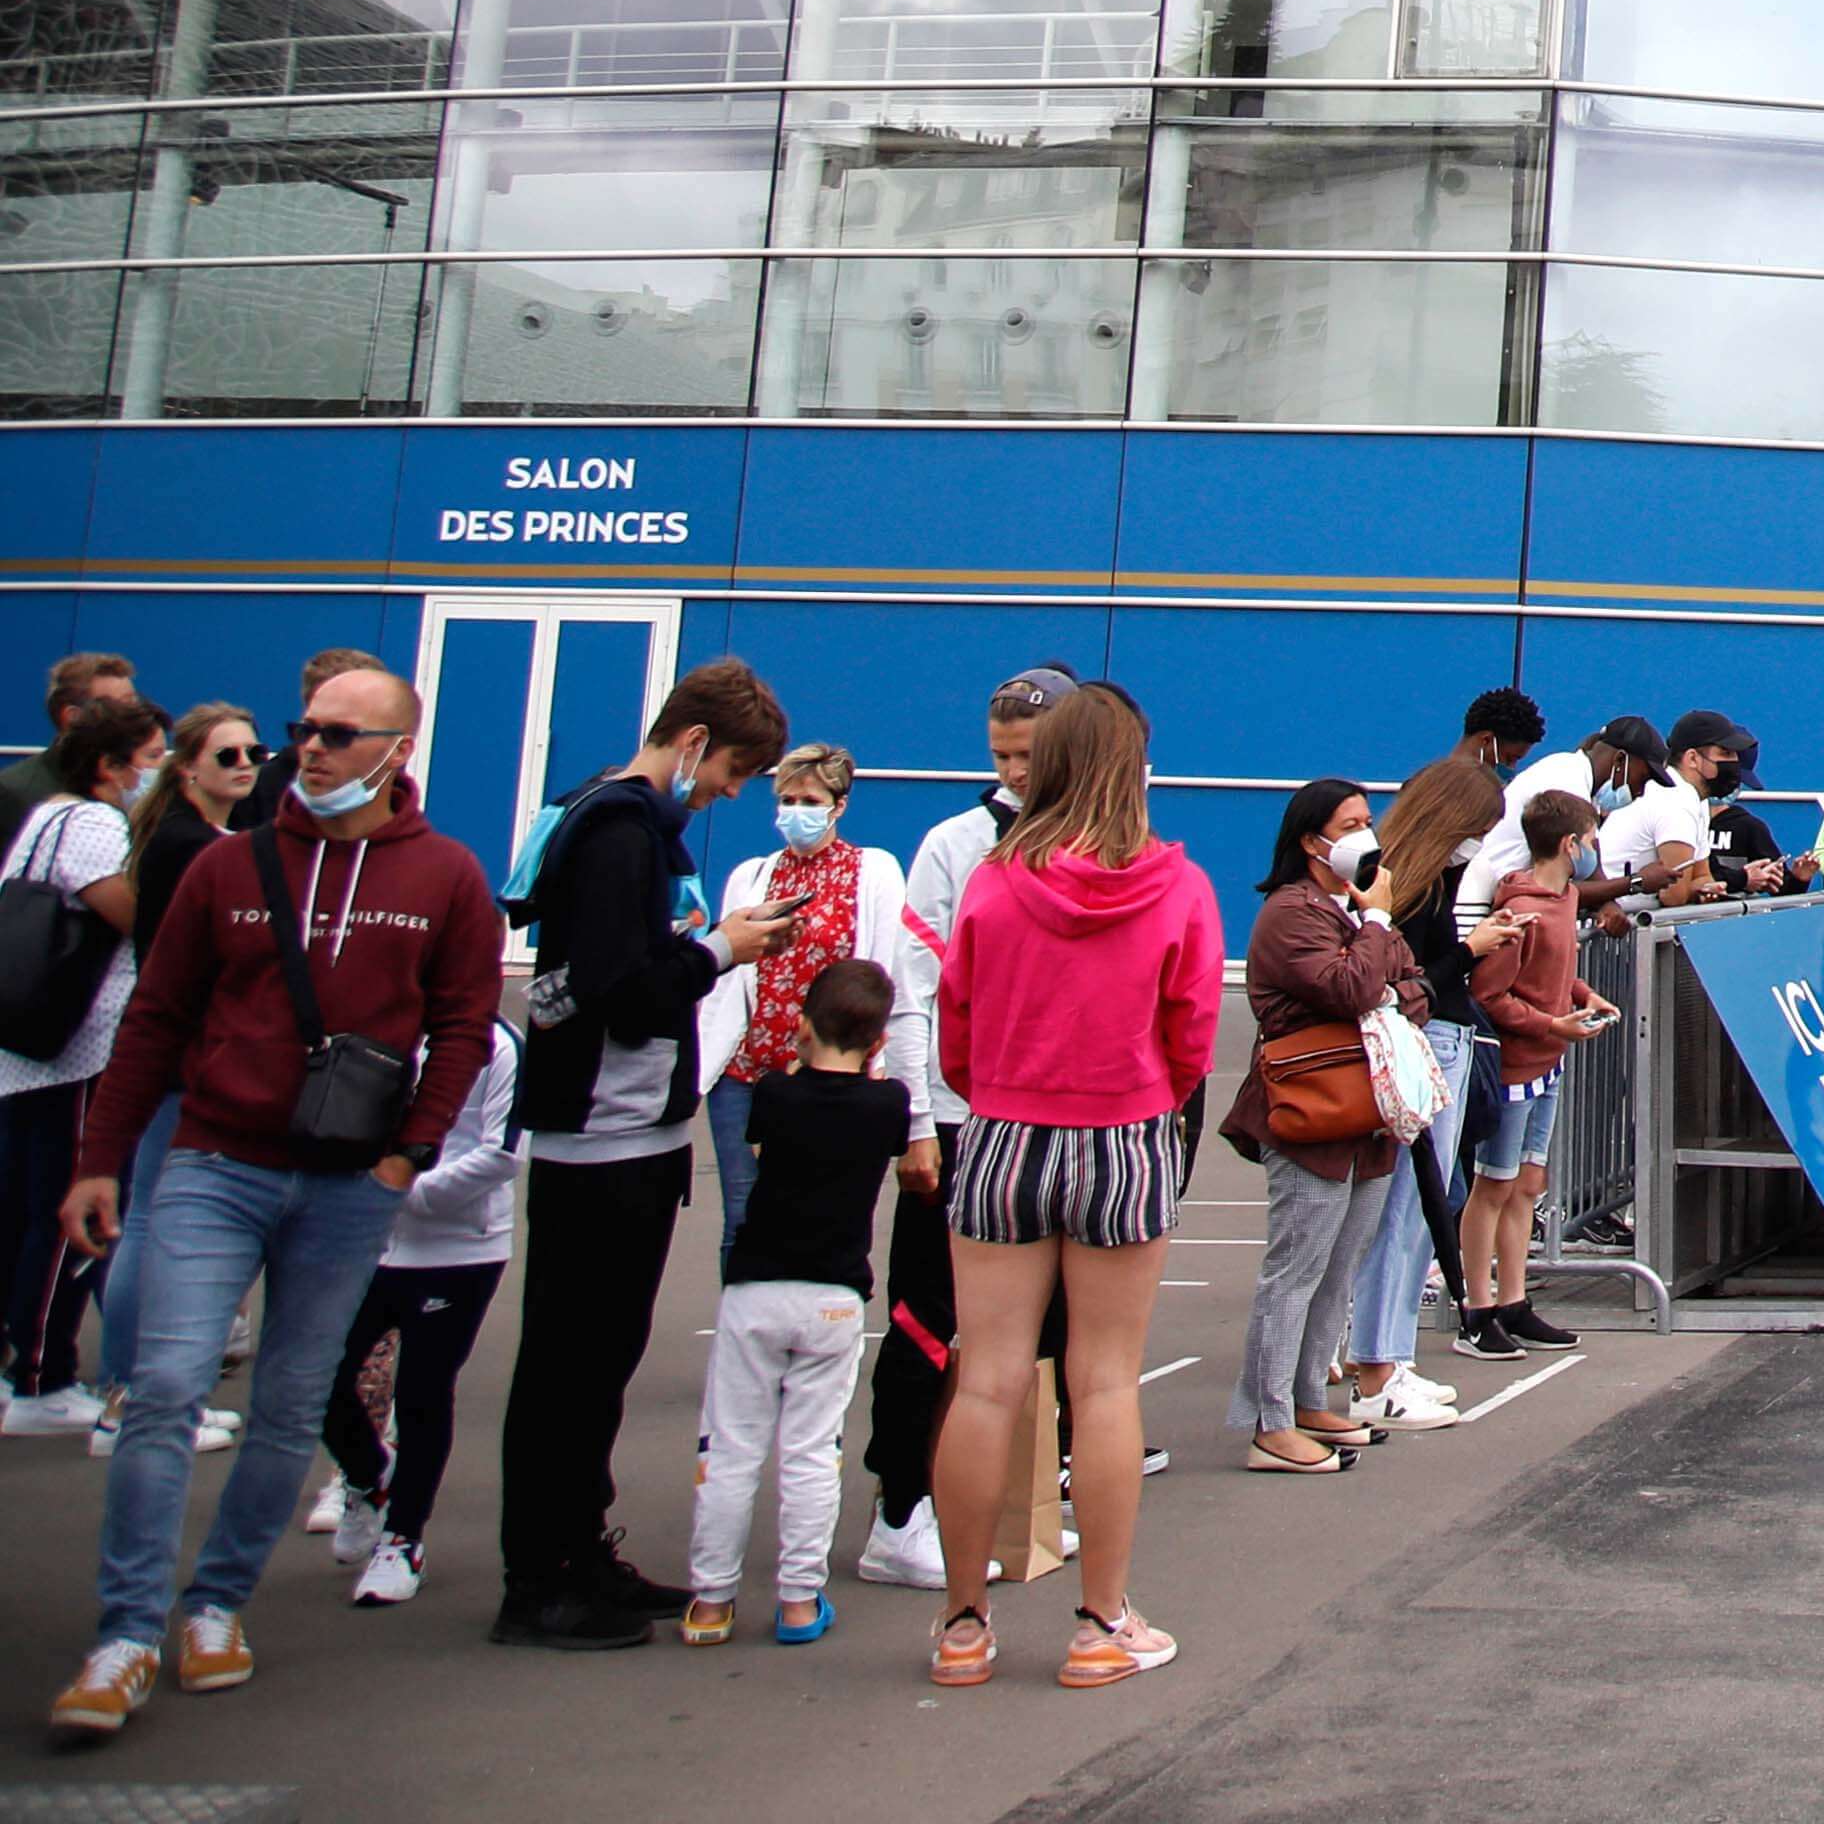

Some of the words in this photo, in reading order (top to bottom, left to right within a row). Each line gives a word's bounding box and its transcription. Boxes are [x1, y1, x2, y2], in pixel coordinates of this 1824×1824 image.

[505, 457, 636, 490] SALON
[439, 509, 515, 542] DES
[523, 510, 689, 545] PRINCES
